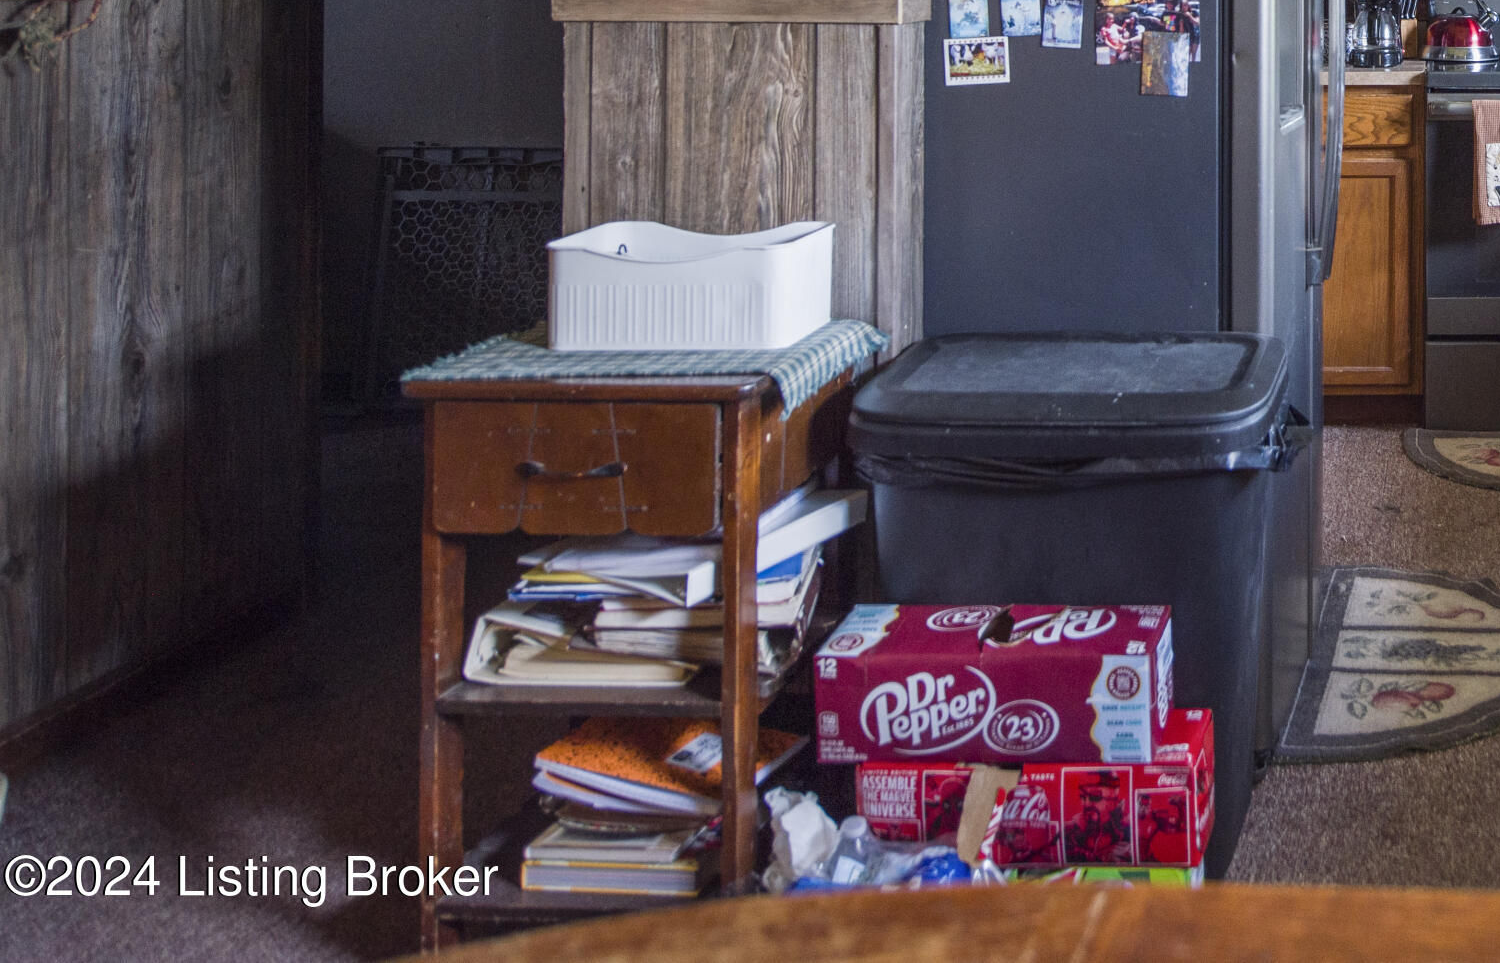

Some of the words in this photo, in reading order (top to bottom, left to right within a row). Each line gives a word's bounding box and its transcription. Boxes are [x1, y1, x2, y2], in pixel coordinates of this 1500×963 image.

[816, 657, 837, 672] 12
[905, 671, 955, 710] Dr
[860, 681, 986, 746] Pepper
[1005, 715, 1036, 742] 23
[862, 775, 917, 790] ASSEMBLE
[863, 789, 878, 802] THE
[880, 789, 916, 802] MARVEL
[863, 802, 917, 818] UNIVERSE
